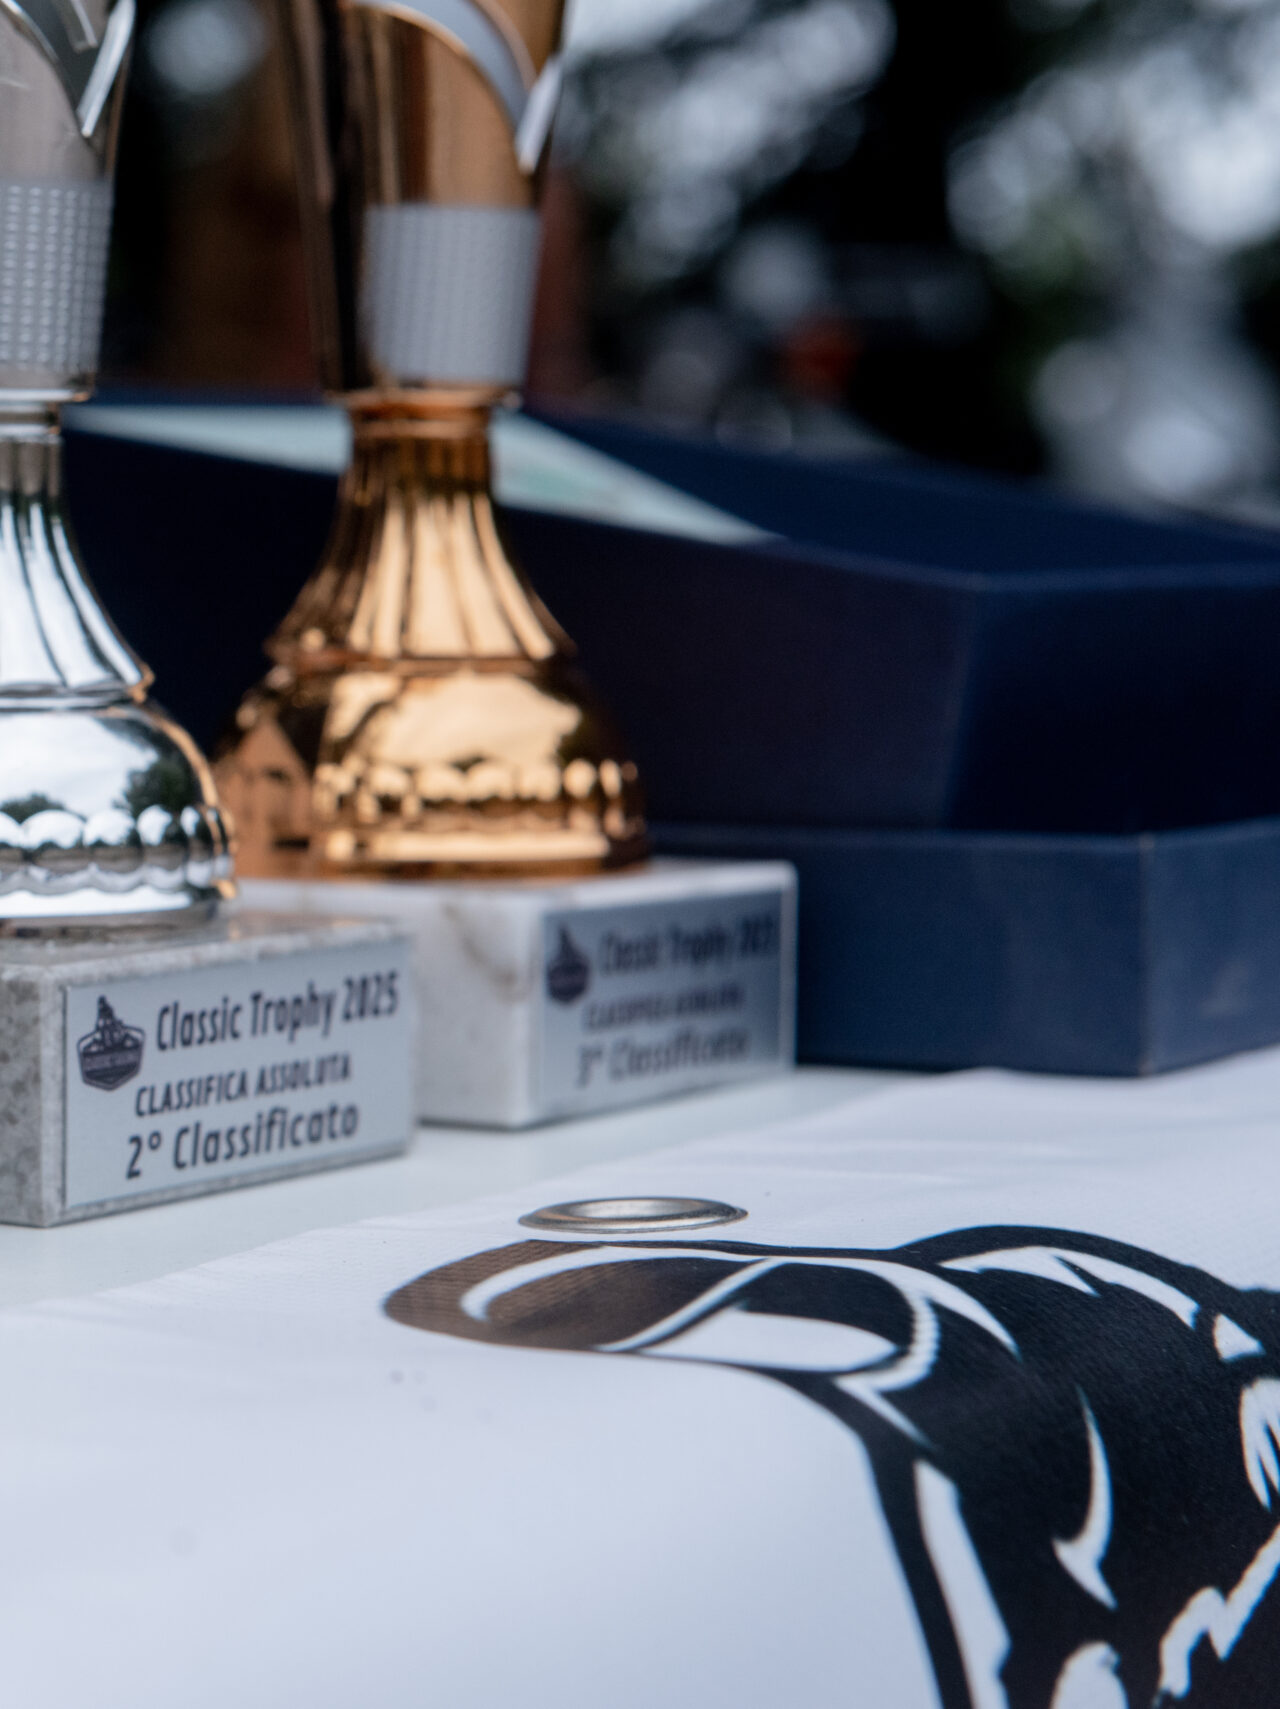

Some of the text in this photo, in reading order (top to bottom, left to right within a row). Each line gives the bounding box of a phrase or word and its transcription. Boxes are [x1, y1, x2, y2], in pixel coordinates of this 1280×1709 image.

[156, 970, 401, 1052] Classic Trophy 2025
[134, 1053, 352, 1118] CLASSIFICA ASSOLUTA
[126, 1103, 360, 1180] 2° Classificato
